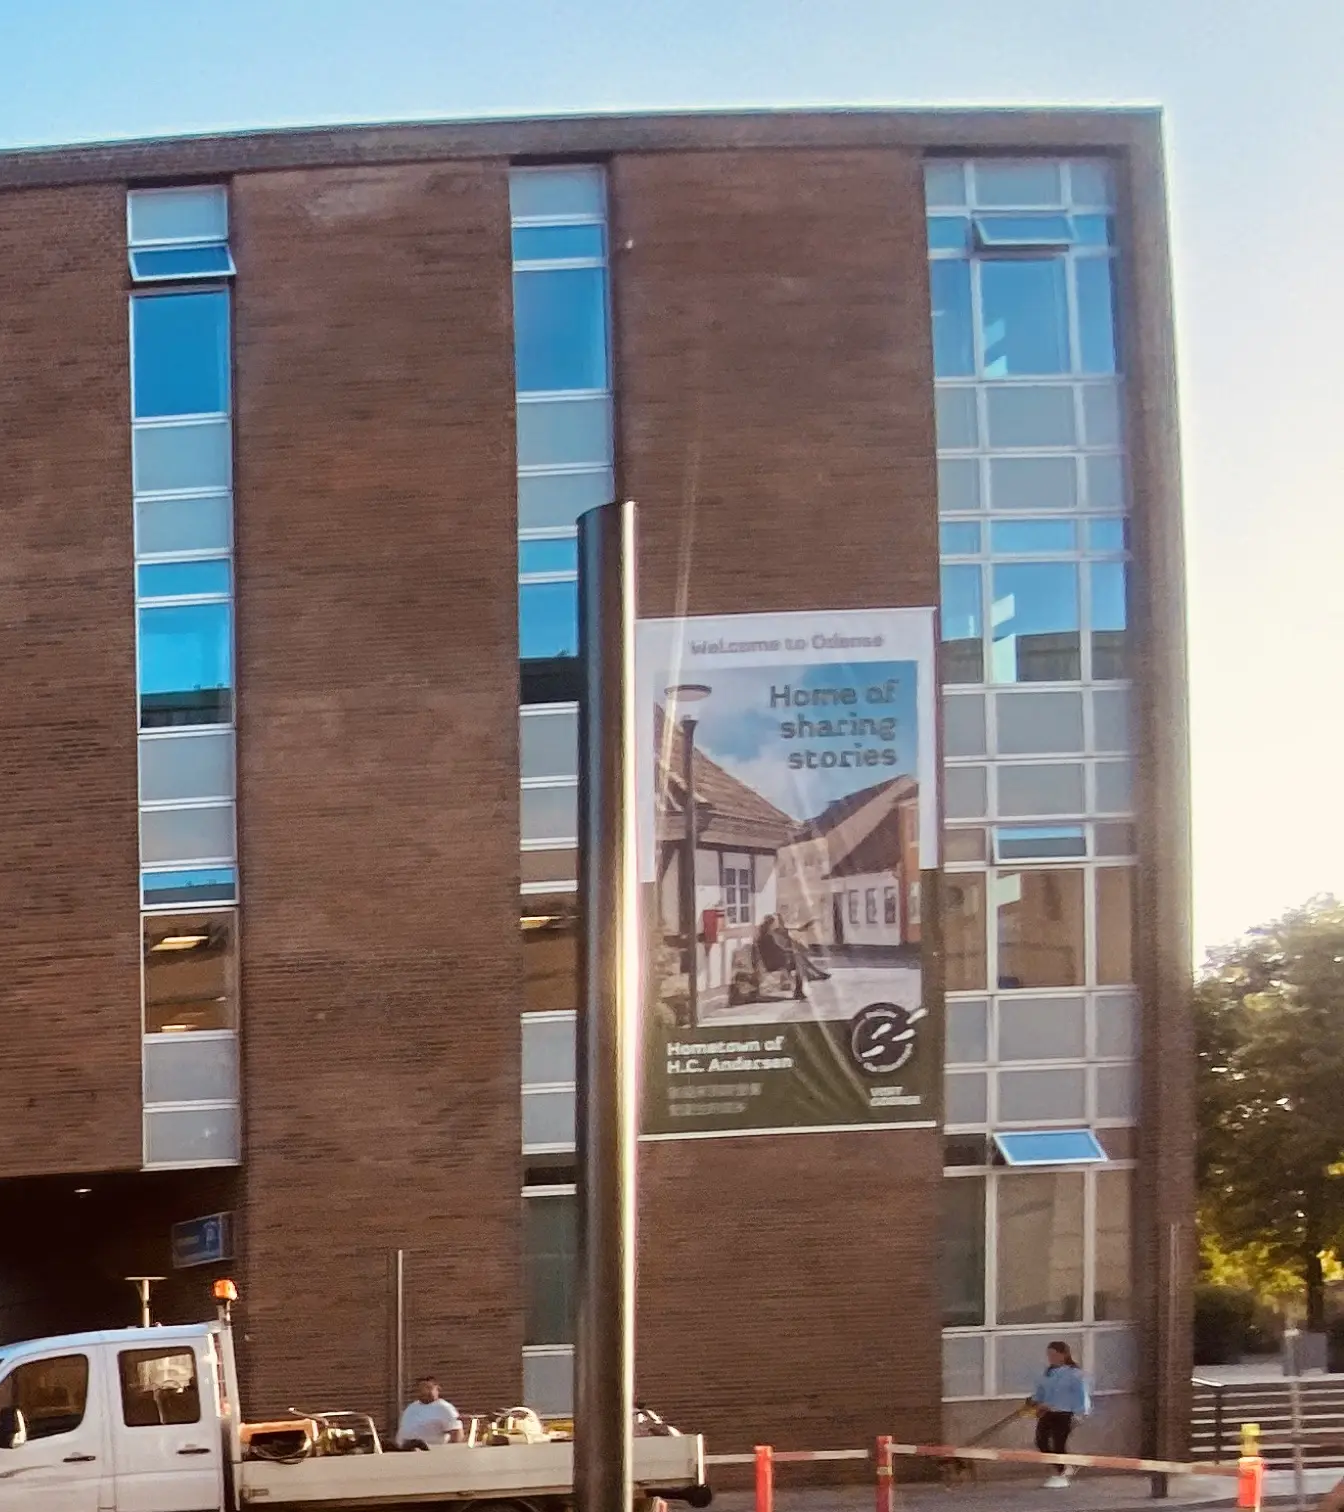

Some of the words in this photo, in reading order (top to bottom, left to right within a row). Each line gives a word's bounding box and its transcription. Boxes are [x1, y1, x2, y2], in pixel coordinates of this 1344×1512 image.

[690, 637, 781, 655] Welcome
[784, 636, 806, 651] to
[812, 631, 884, 650] Odense
[769, 683, 858, 709] Home
[865, 678, 899, 704] of
[781, 711, 898, 742] sharing
[789, 742, 898, 770] stories
[666, 1039, 761, 1057] Hometown
[764, 1034, 785, 1052] of
[666, 1058, 706, 1074] H.C.
[707, 1056, 793, 1073] Andersen
